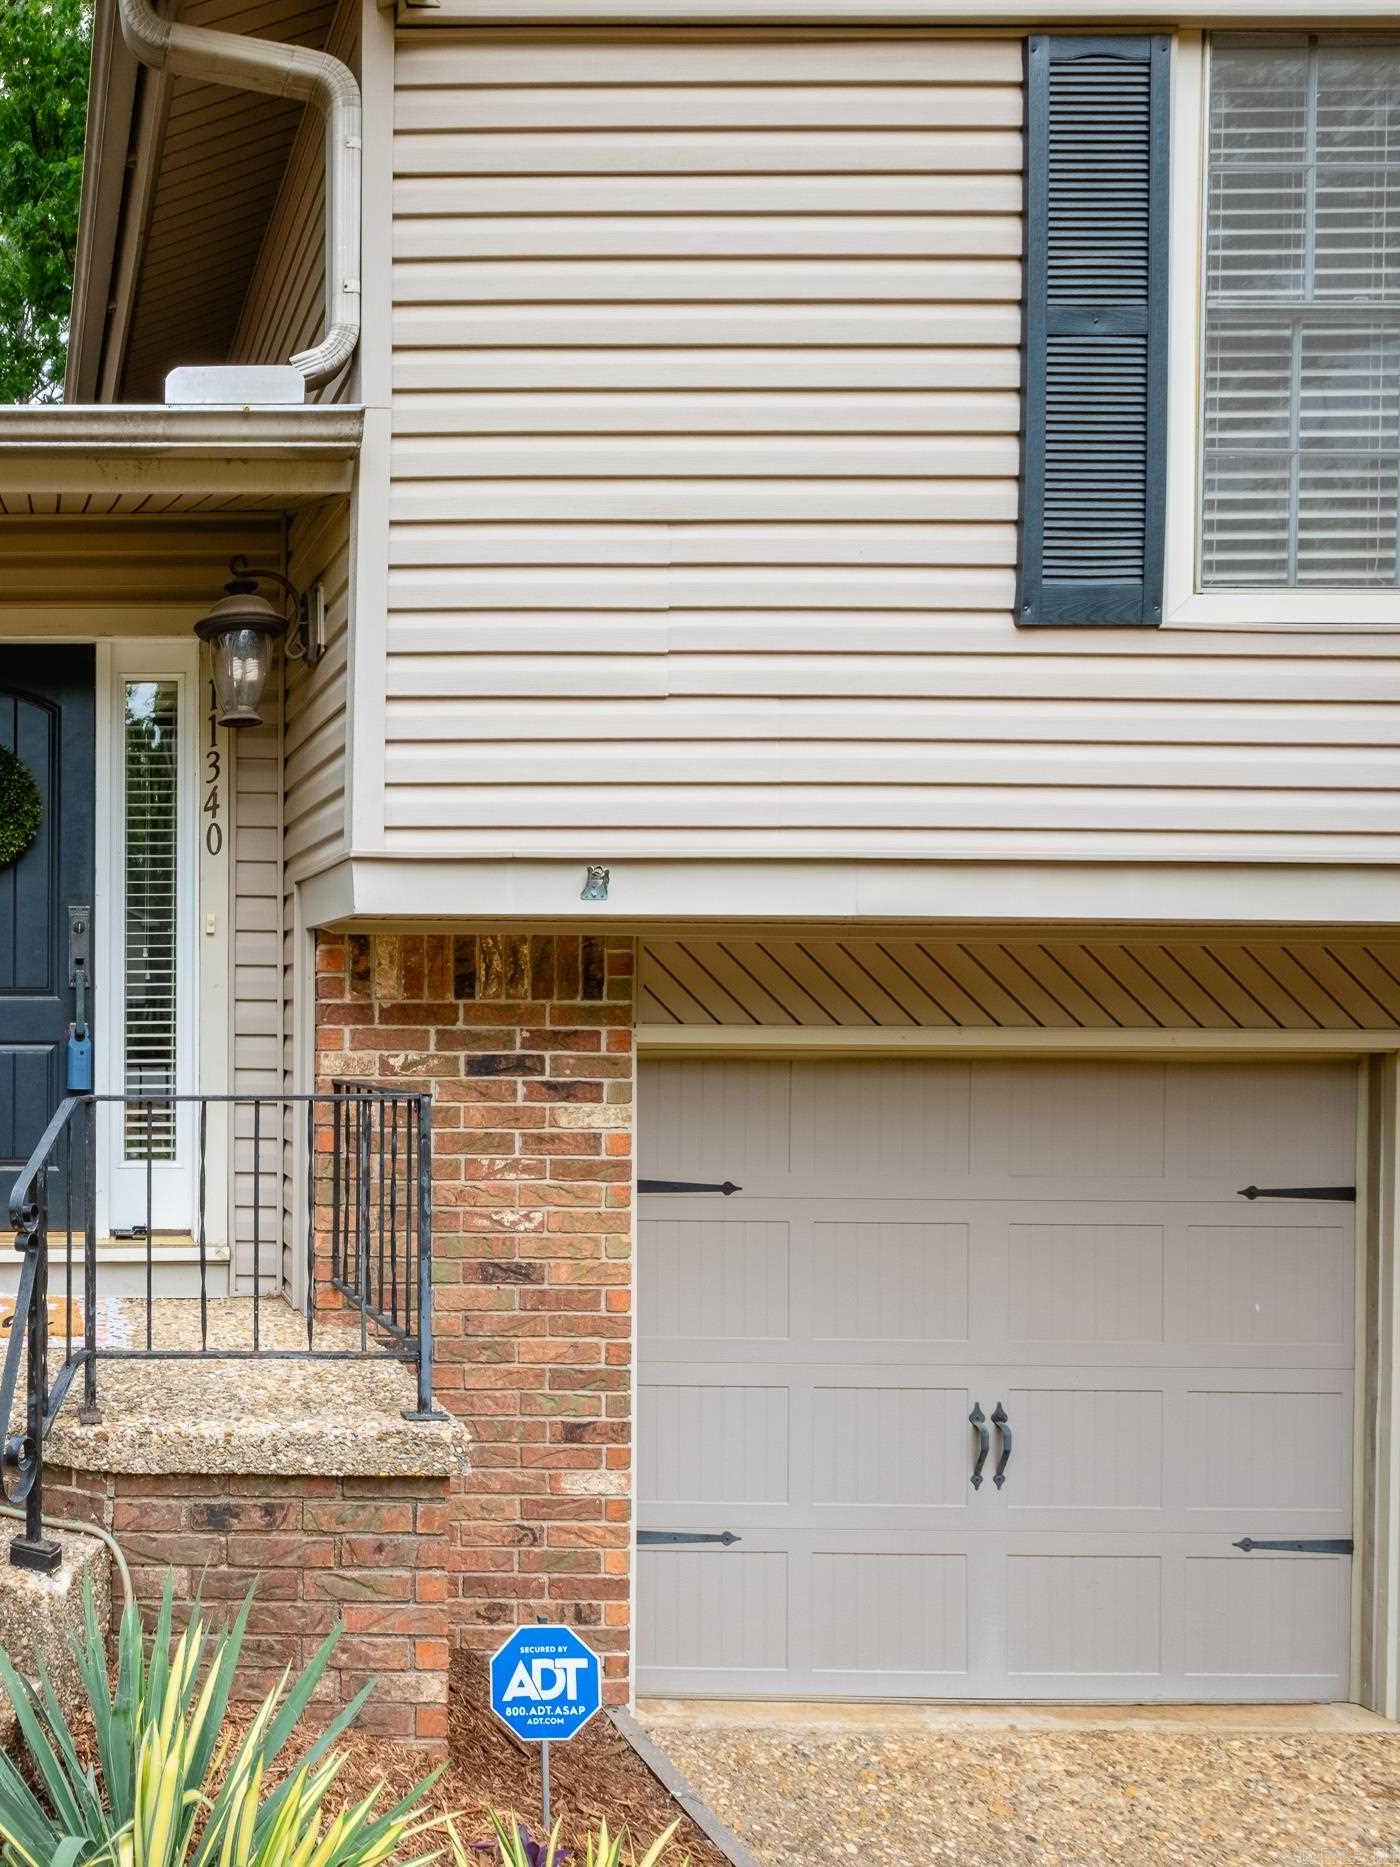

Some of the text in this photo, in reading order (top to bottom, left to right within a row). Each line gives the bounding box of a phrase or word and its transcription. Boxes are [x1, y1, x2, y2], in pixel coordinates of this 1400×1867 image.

[203, 679, 223, 856] 11340
[519, 1645, 568, 1654] SECURED BY
[501, 1657, 589, 1702] ADT
[505, 1705, 586, 1717] 800.ADT.ASAP
[526, 1717, 565, 1725] ADT.COM
